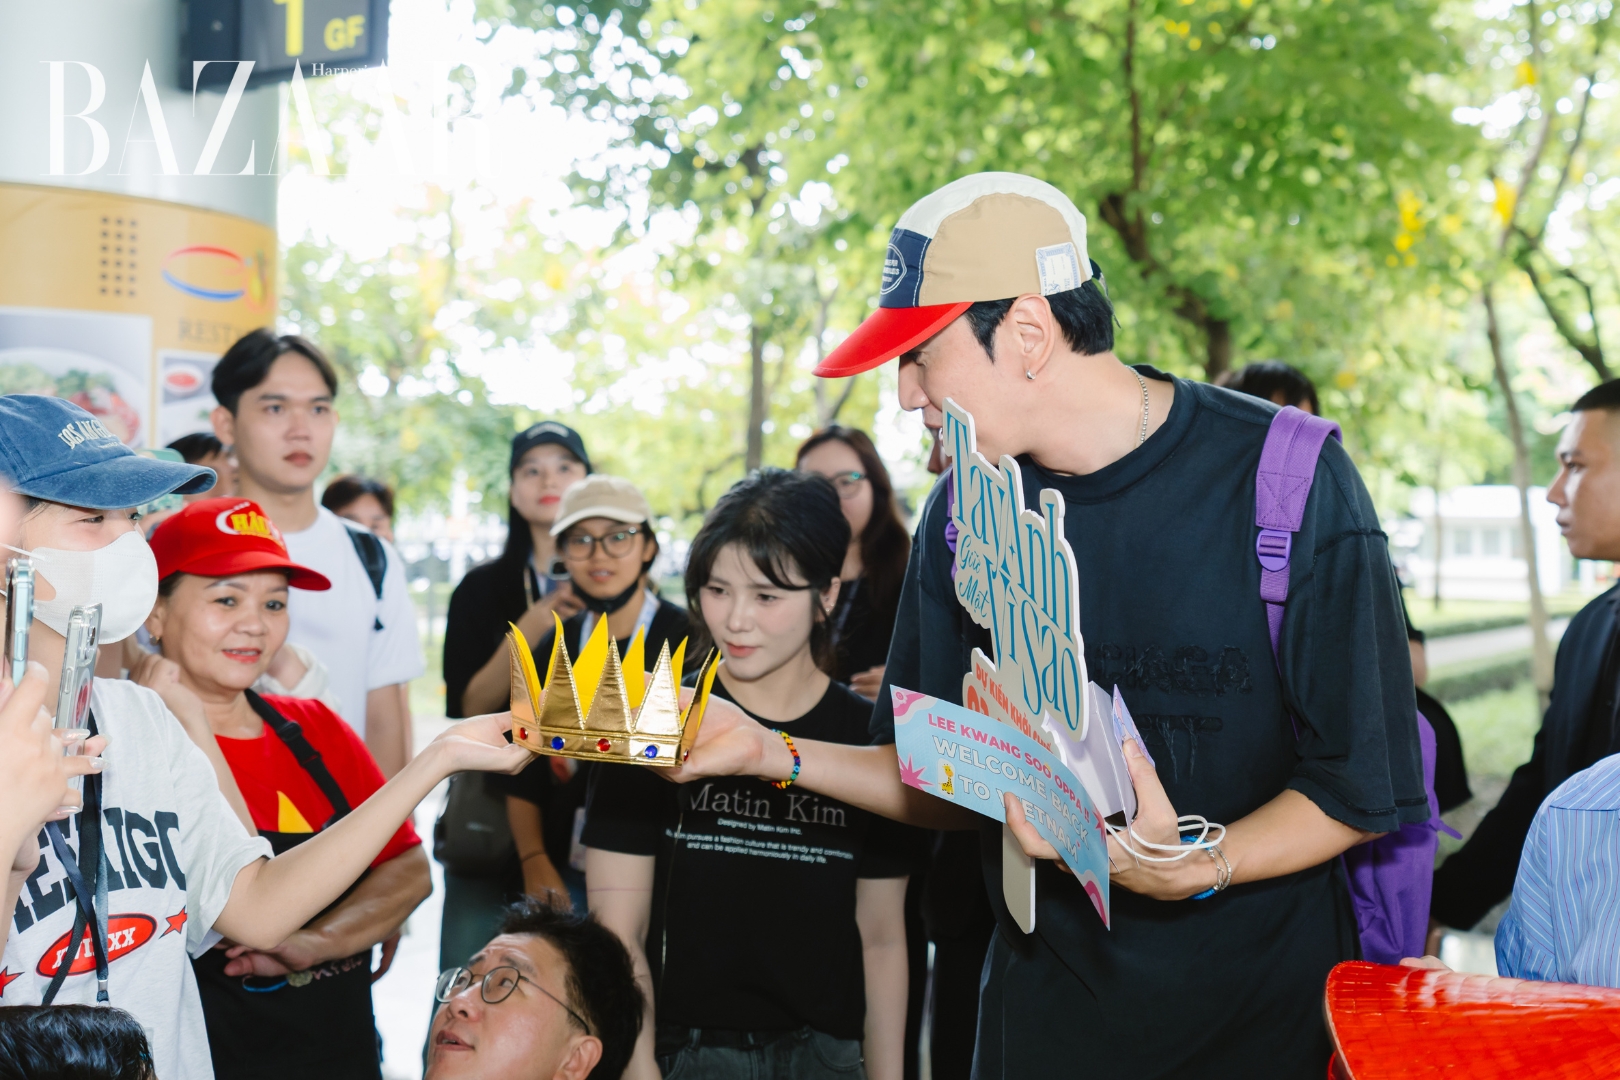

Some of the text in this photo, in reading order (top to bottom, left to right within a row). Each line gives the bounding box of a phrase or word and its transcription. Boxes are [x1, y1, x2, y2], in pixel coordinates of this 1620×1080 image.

[323, 14, 366, 52] GF
[57, 423, 85, 450] LOS
[946, 410, 1074, 646] Tay Anh
[1021, 599, 1081, 732] Sao
[928, 713, 957, 734] LEE
[960, 724, 1021, 759] KWANG
[1024, 752, 1052, 779] SOO
[1054, 774, 1083, 814] OPPA
[690, 783, 848, 828] Matin Kim
[932, 734, 1048, 800] WELCOME
[1050, 788, 1090, 851] BACK
[957, 774, 991, 801] TO
[717, 817, 748, 830] Designed
[776, 825, 790, 834] Kim
[720, 834, 745, 845] fashion
[767, 841, 780, 850] that
[787, 843, 810, 855] trendy
[810, 847, 824, 855] and
[687, 841, 701, 850] and
[701, 842, 714, 851] can
[714, 843, 724, 852] be
[724, 845, 749, 856] applied
